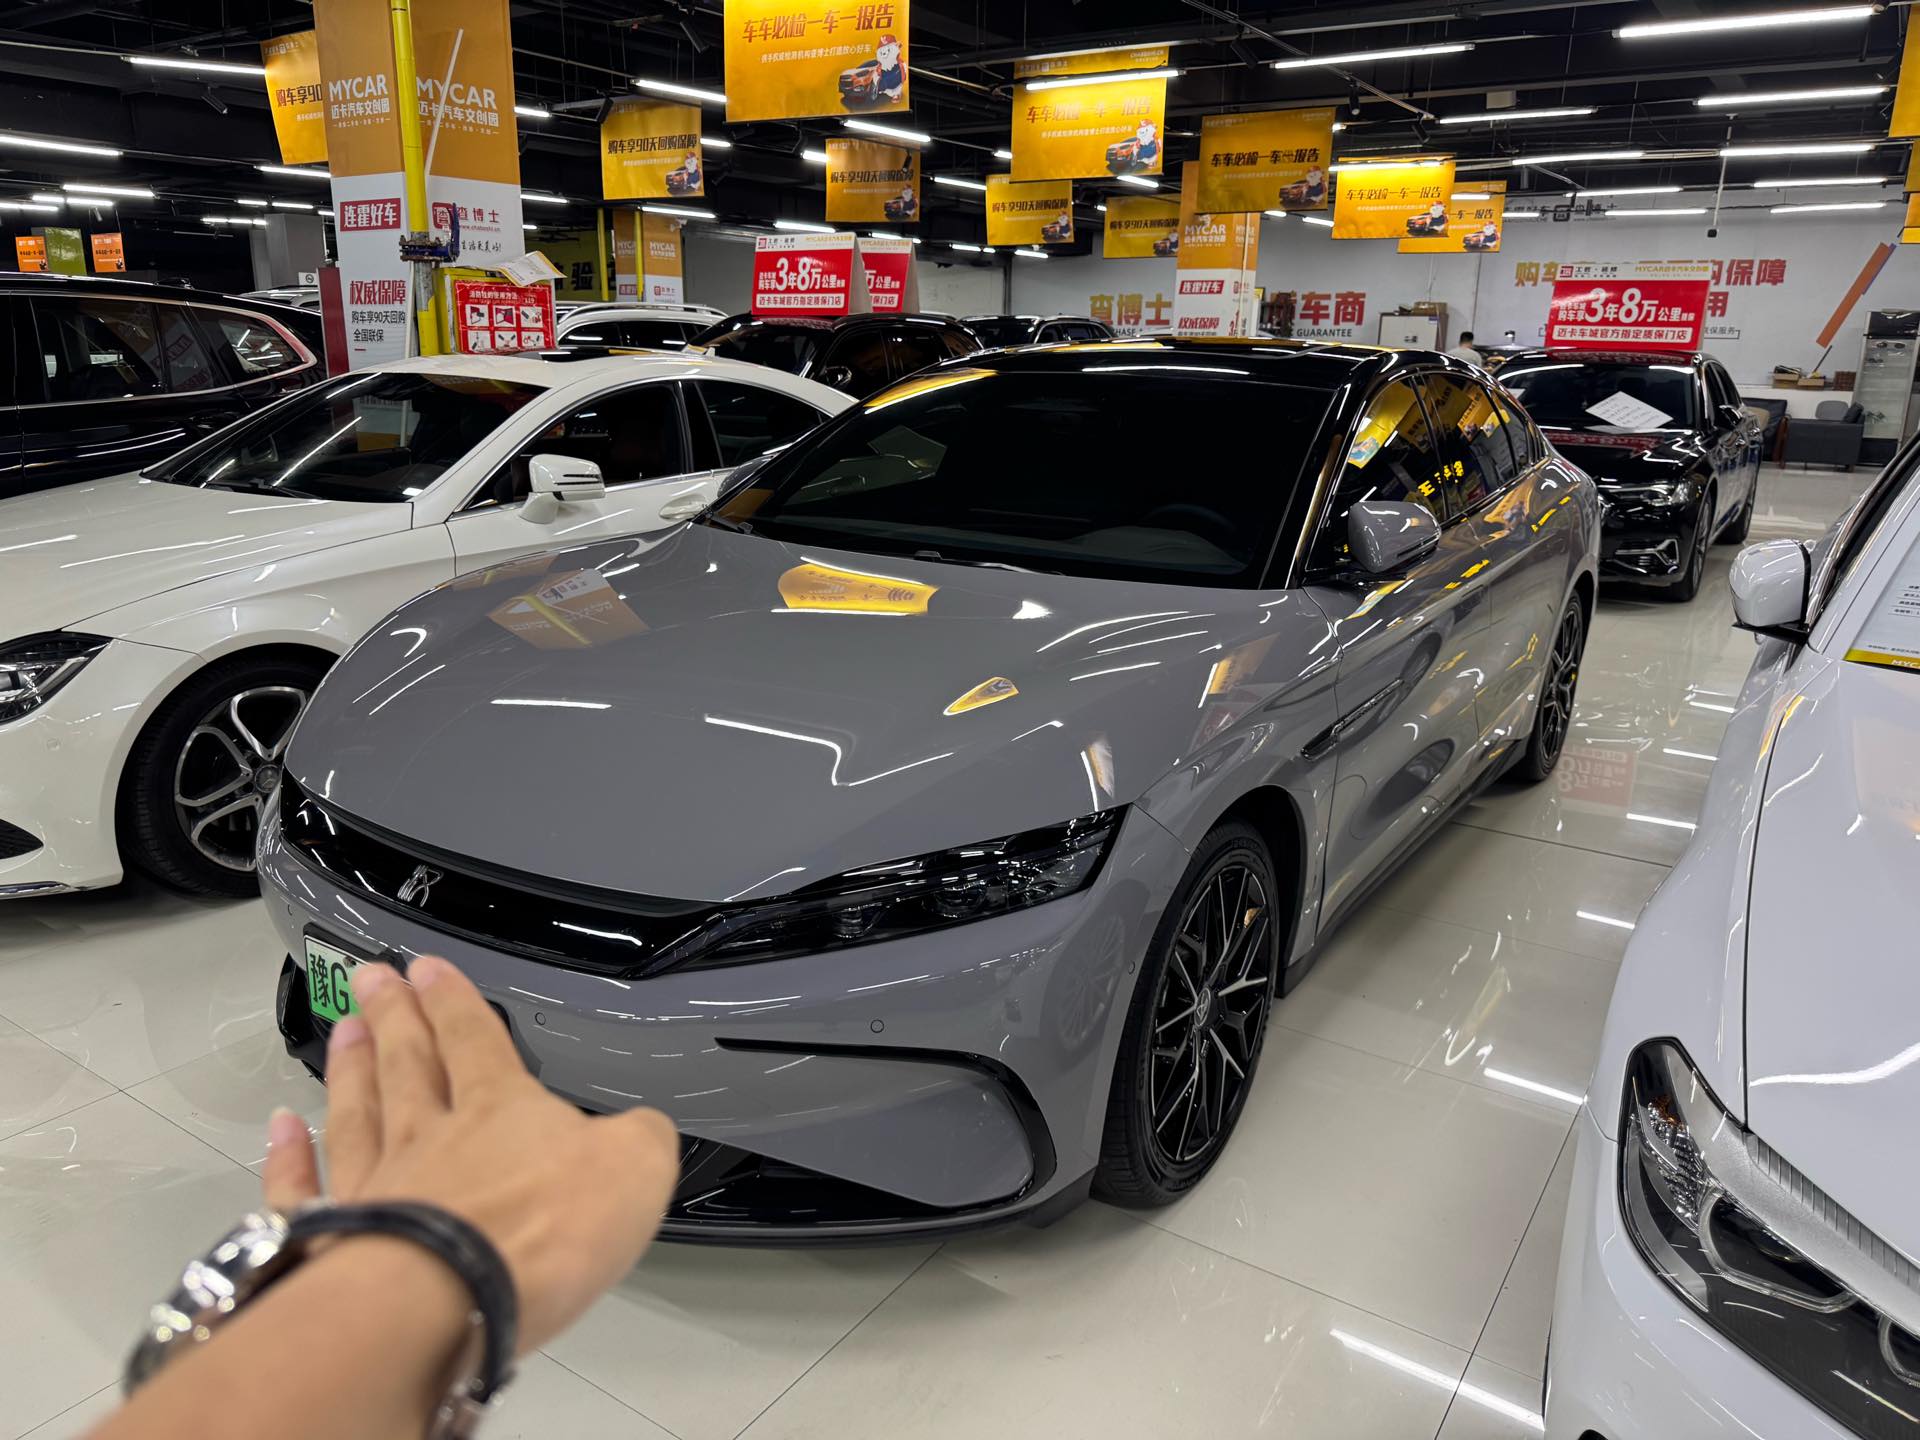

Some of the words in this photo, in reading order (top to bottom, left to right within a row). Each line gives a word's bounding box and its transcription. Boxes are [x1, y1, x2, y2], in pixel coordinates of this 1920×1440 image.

[742, 3, 894, 42] 车车必检一车一报告
[329, 74, 388, 101] MYCAR
[416, 76, 498, 110] MYCAR
[331, 98, 390, 119] 迈卡汽车文创园
[607, 133, 698, 154] 购车享90天回购保障
[344, 202, 398, 228] 连霍好车
[457, 206, 500, 224] 查博士
[1185, 224, 1226, 235] MYCAR
[350, 280, 407, 305] 权威保障
[351, 311, 406, 325] 购车享90天回购
[353, 329, 384, 342] 全国联保
[1113, 328, 1136, 336] HASE
[1297, 328, 1352, 338] GUARANTEE
[1557, 327, 1688, 341] 迈卡车城官方指定质保门店
[310, 952, 350, 1016] 豫G
